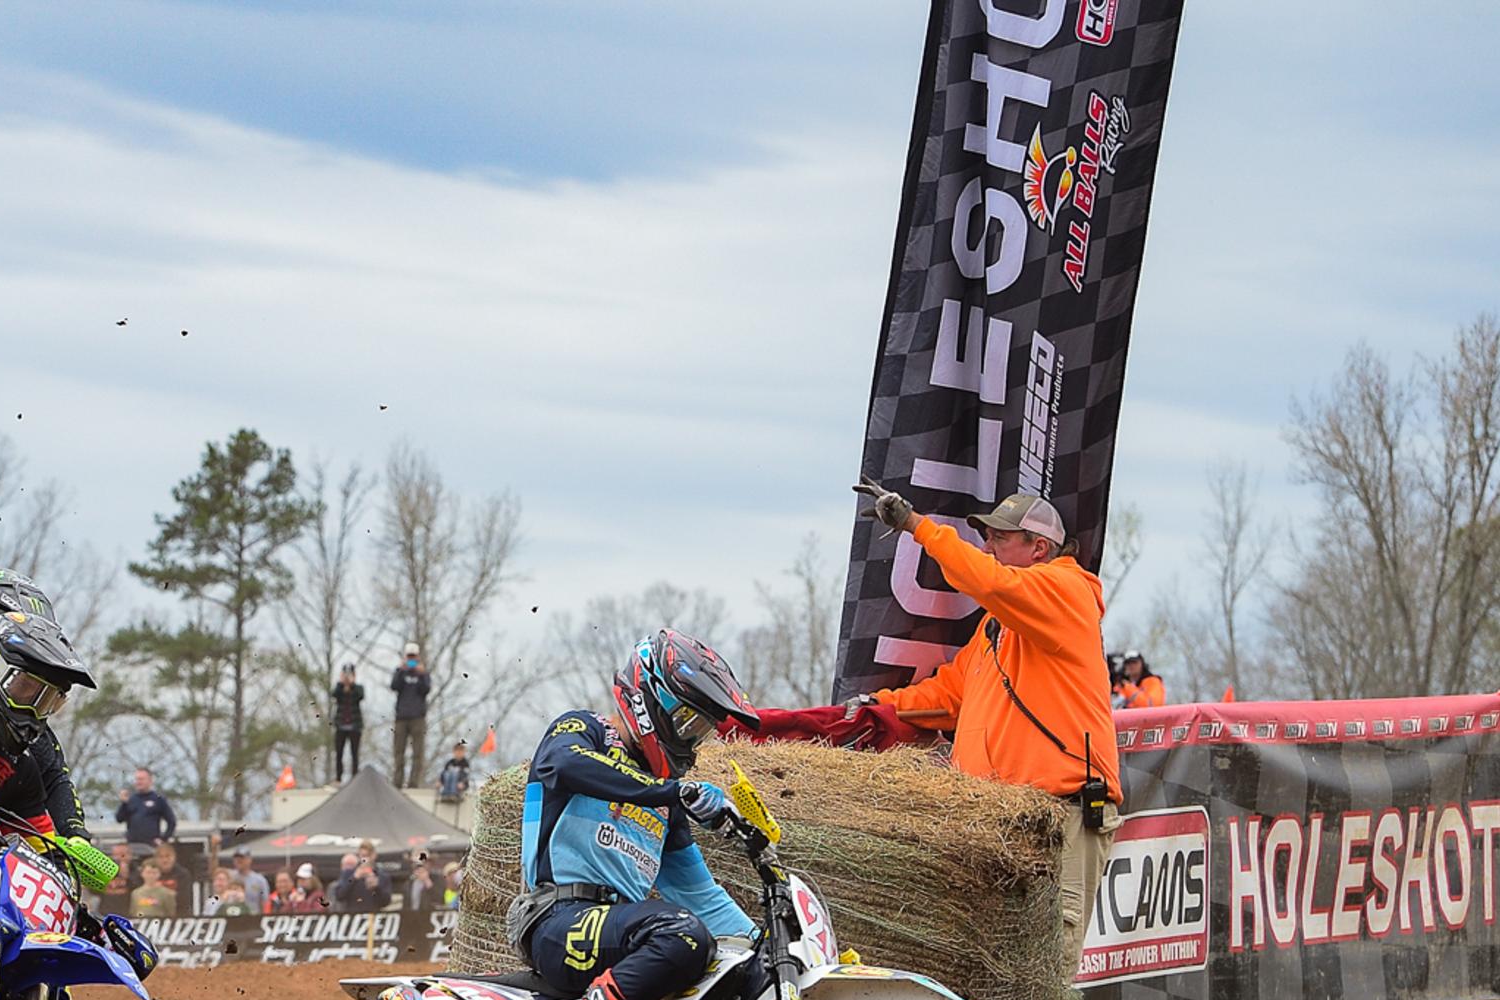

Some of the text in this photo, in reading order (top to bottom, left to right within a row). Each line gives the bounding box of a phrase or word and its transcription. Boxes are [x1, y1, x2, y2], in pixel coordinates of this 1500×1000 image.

[1098, 96, 1132, 174] Racing
[1063, 92, 1107, 293] ALL BALLS
[1043, 353, 1065, 499] Performance Products
[631, 693, 655, 734] 212
[9, 860, 74, 935] 523
[1229, 799, 1500, 953] HOLESHOT
[254, 912, 401, 945] SPECIALIZED
[1108, 948, 1124, 969] THE
[1125, 945, 1158, 967] POWER
[1160, 940, 1198, 962] WITHIN
